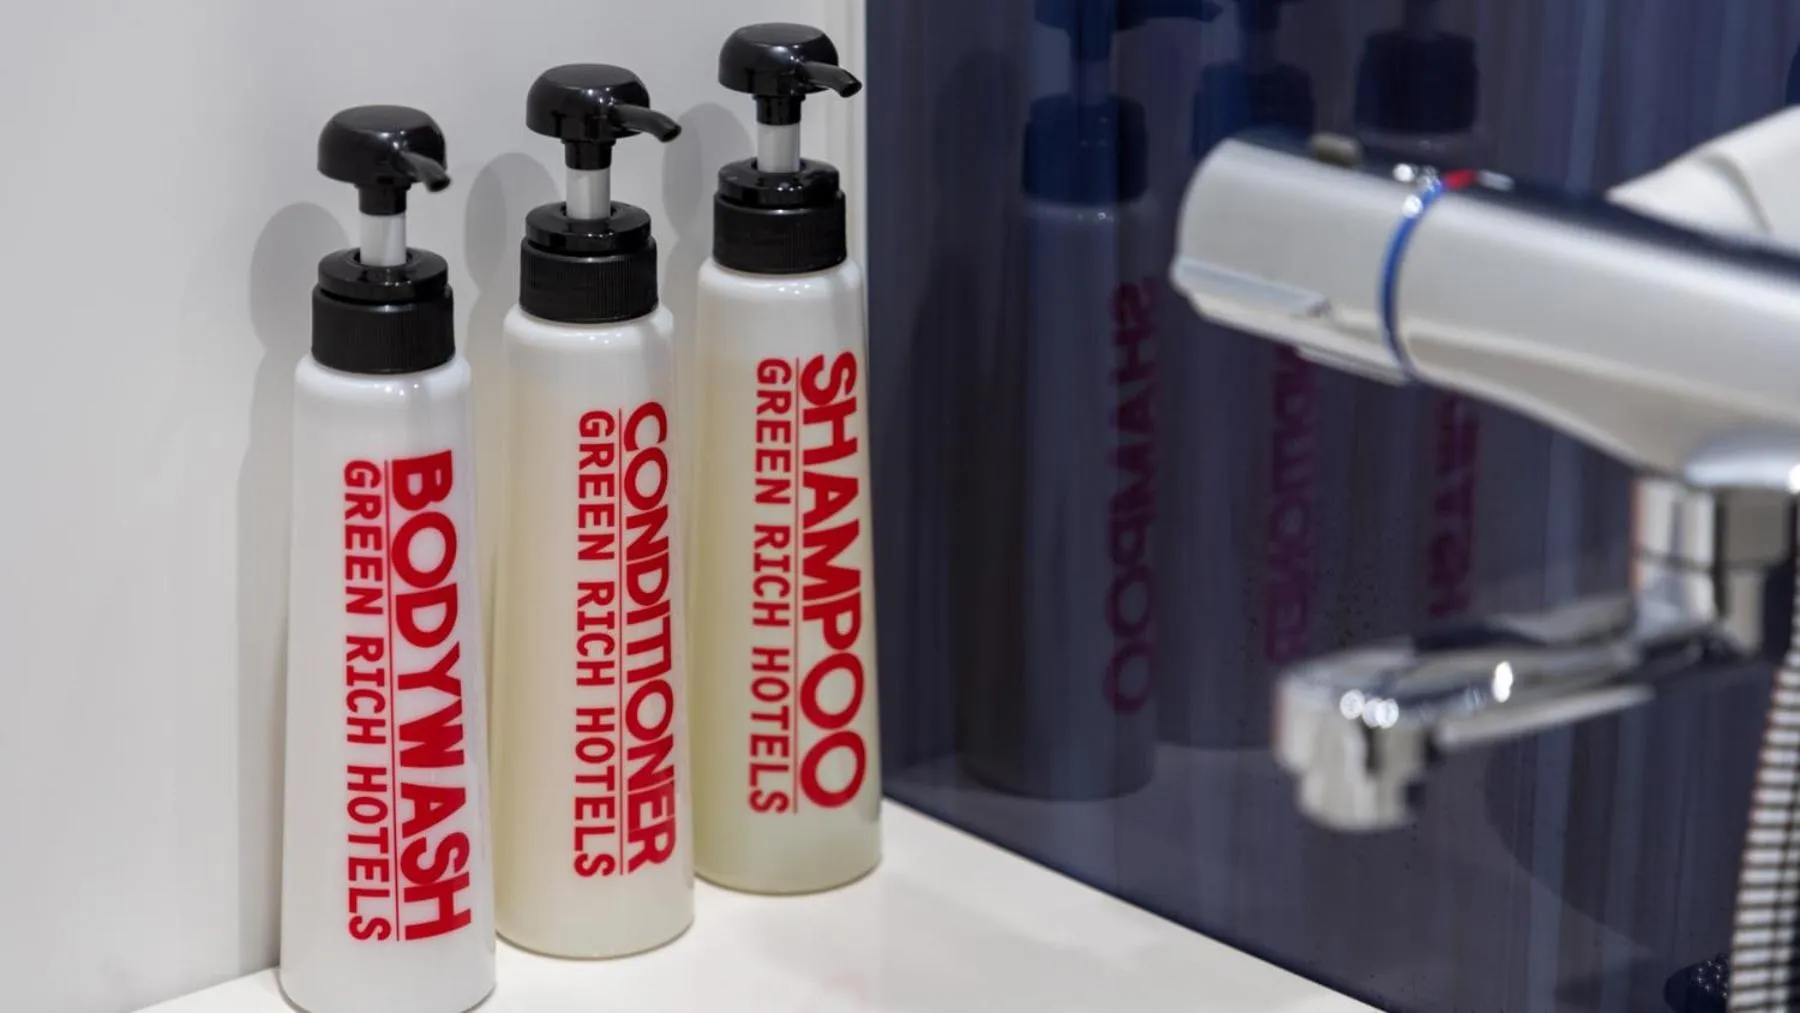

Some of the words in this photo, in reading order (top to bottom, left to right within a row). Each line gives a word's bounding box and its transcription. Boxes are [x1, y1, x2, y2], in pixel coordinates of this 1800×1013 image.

[577, 410, 616, 561] GREEN
[755, 358, 793, 505] GREEN
[344, 460, 384, 615] GREEN
[752, 523, 791, 628] RICH
[800, 352, 868, 809] SHAMPOO
[346, 636, 386, 745] RICH
[392, 449, 472, 941] BODYWASH
[576, 580, 616, 687] RICH
[622, 401, 677, 874] CONDITIONER
[574, 706, 617, 879] HOTELS
[749, 647, 790, 814] HOTELS
[347, 765, 391, 941] HOTELS
